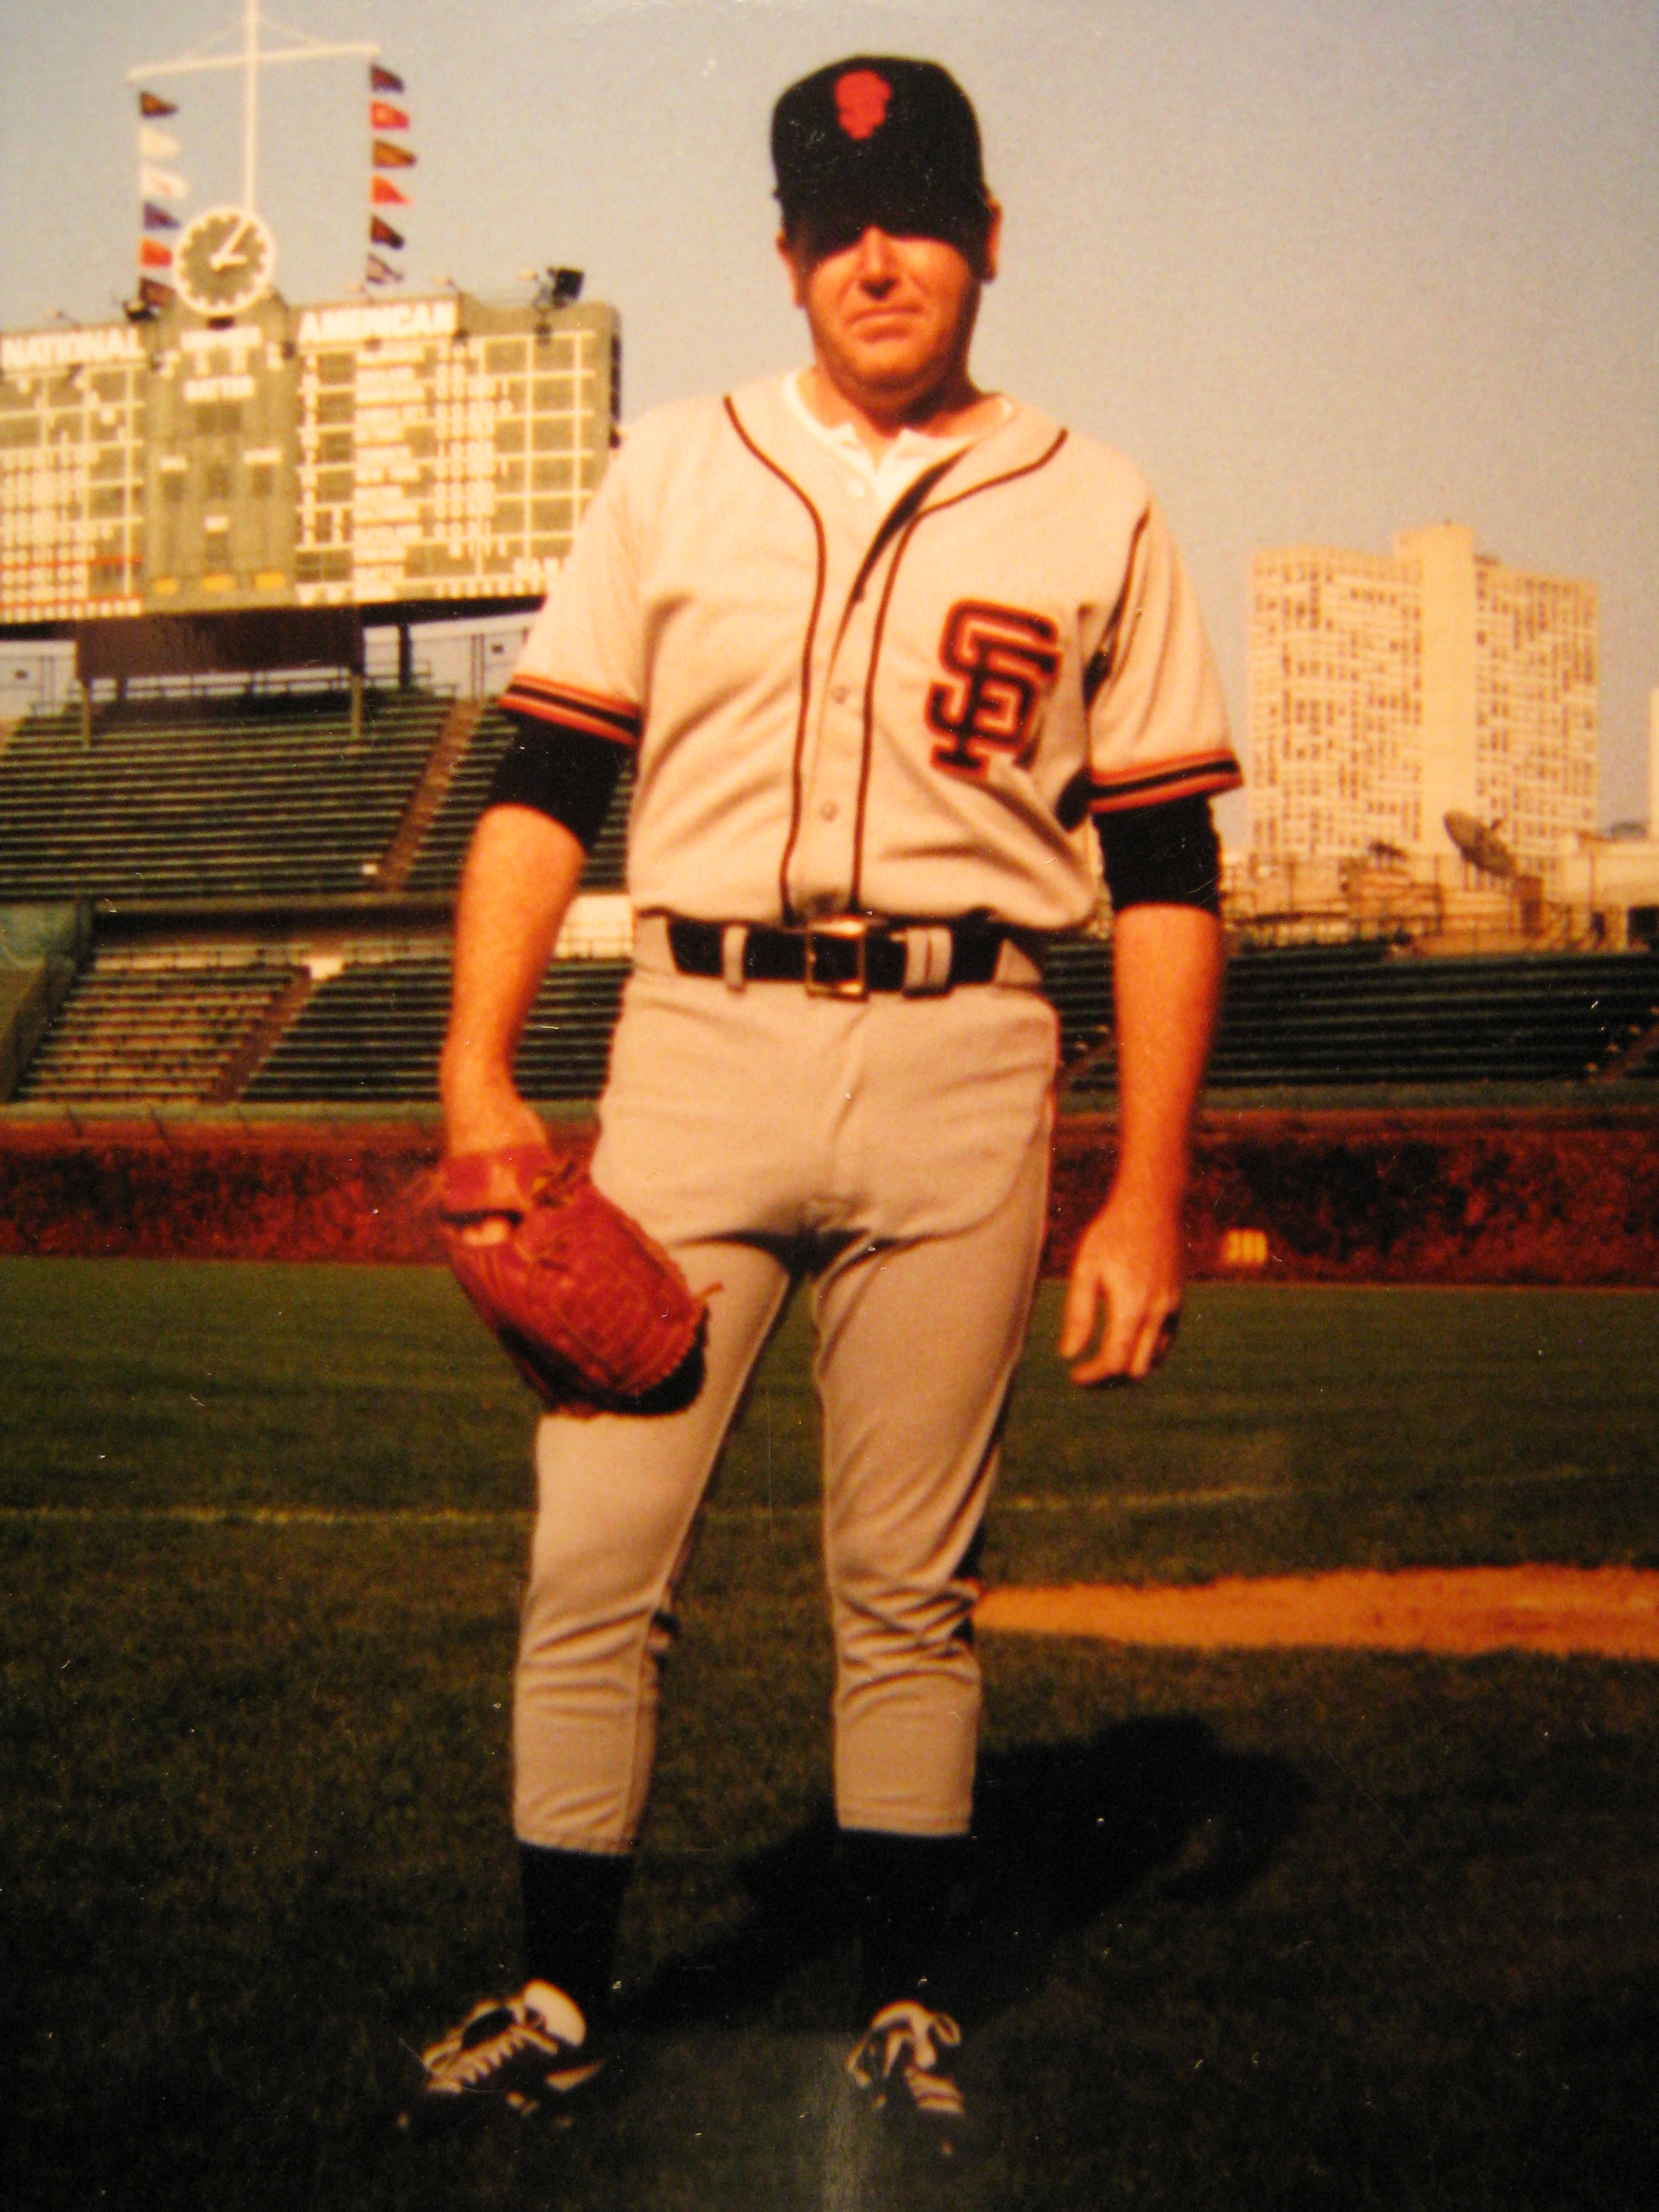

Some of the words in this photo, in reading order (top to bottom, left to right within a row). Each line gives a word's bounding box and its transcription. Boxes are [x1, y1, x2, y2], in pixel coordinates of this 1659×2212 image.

[298, 301, 455, 343] AMERICAN
[1, 326, 145, 370] NATIONAL
[924, 598, 1061, 779] SF
